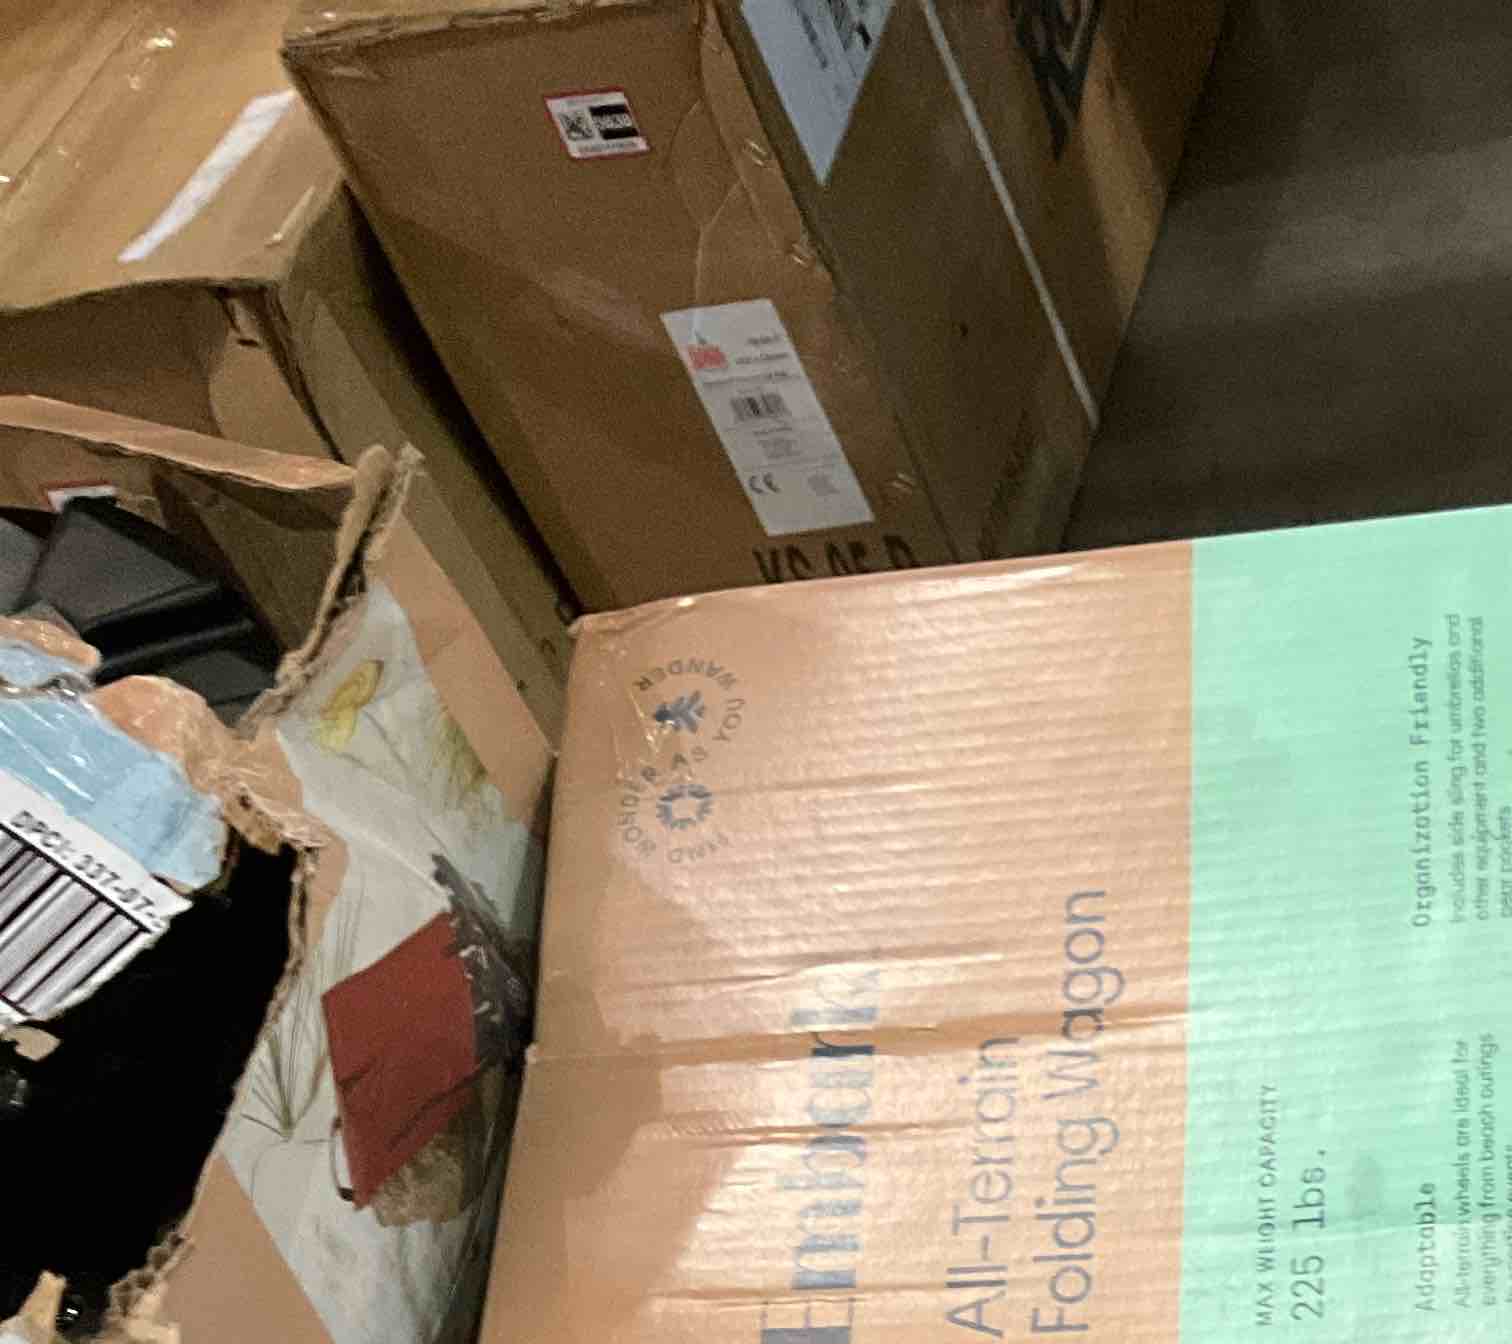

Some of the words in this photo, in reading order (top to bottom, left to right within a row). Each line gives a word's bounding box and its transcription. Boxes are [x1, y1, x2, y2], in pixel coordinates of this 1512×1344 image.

[1445, 612, 1460, 646] and
[1468, 615, 1485, 702] additional
[631, 658, 736, 691] WANDER
[1407, 636, 1431, 746] Friendly
[1443, 650, 1463, 733] umbrellas
[711, 698, 744, 742] YOU
[1446, 738, 1462, 762] for
[1470, 705, 1486, 738] two
[1447, 765, 1466, 806] sling
[1471, 742, 1487, 775] and
[1410, 759, 1435, 927] Organization
[1447, 810, 1463, 846] side
[1470, 781, 1490, 871] equipment
[1448, 850, 1465, 923] Includes
[1473, 874, 1488, 920] other
[1040, 889, 1129, 1099] Wagon
[1452, 1038, 1468, 1064] for
[1477, 1032, 1498, 1099] outings
[1450, 1068, 1470, 1113] ideal
[1257, 1082, 1278, 1188] CAPACITY
[1455, 1116, 1469, 1147] are
[1473, 1103, 1496, 1161] beach
[942, 1036, 1019, 1338] All-Terrain
[1291, 1147, 1327, 1232] lbs.
[1450, 1151, 1473, 1219] wheels
[1475, 1165, 1496, 1208] from
[1027, 1116, 1120, 1334] Folding
[1257, 1196, 1276, 1272] WEIGHT
[1413, 1181, 1437, 1312] Adaptable
[1475, 1211, 1501, 1306] everything
[1254, 1280, 1273, 1326] MAX
[1289, 1253, 1325, 1321] 225
